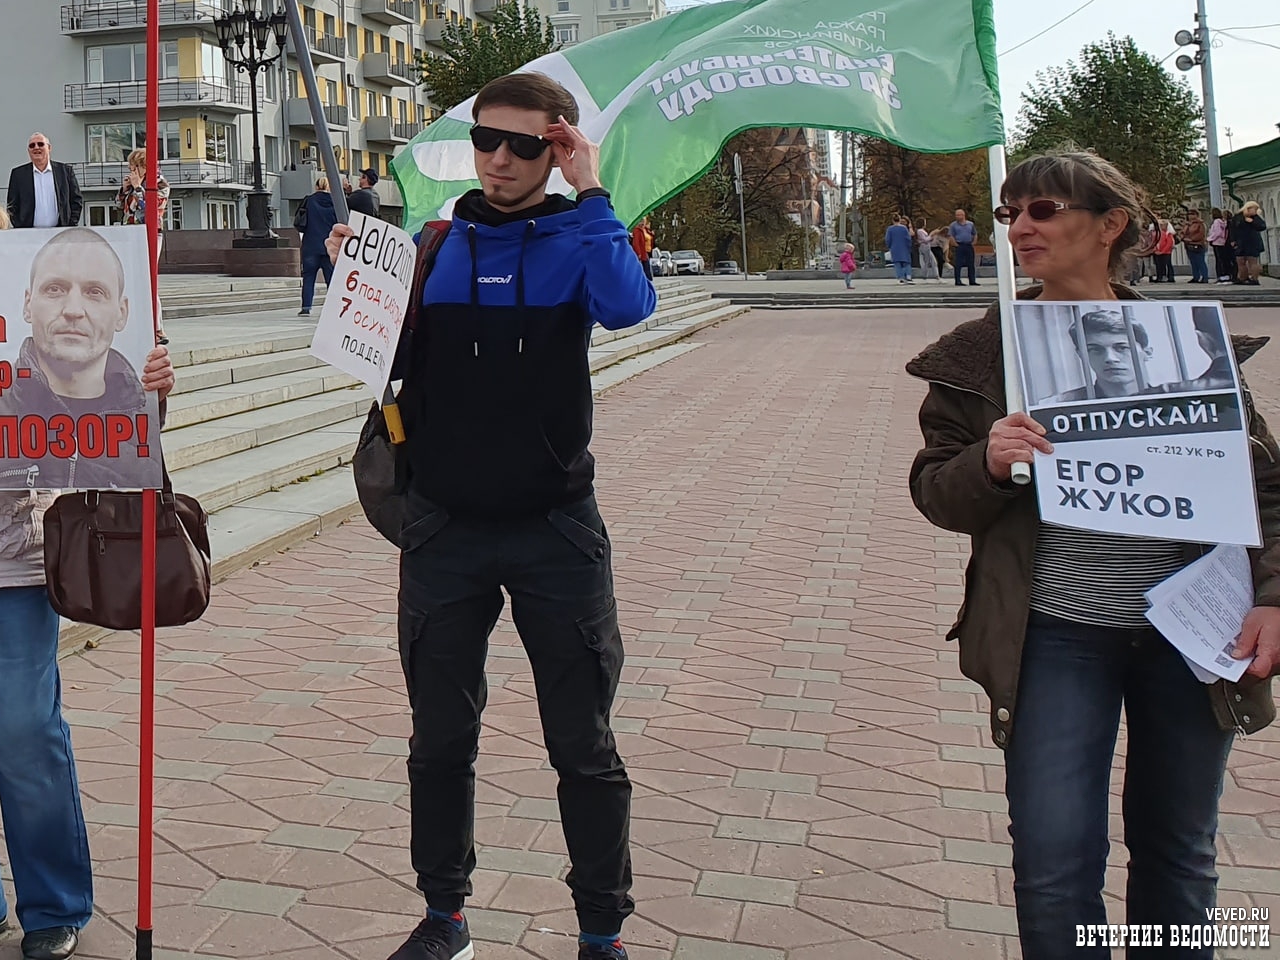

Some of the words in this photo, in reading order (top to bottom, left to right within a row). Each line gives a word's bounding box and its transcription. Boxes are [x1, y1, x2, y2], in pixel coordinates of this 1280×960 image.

[346, 270, 360, 292] 6
[339, 297, 352, 318] 7
[1052, 400, 1220, 433] ОТПУСКАЙ!
[1146, 446, 1162, 455] ст.
[1163, 445, 1182, 456] 212
[1185, 446, 1204, 457] УК
[1206, 448, 1226, 458] РФ
[1055, 458, 1145, 487] ЕГОР
[1056, 484, 1195, 520] ЖУКОВ
